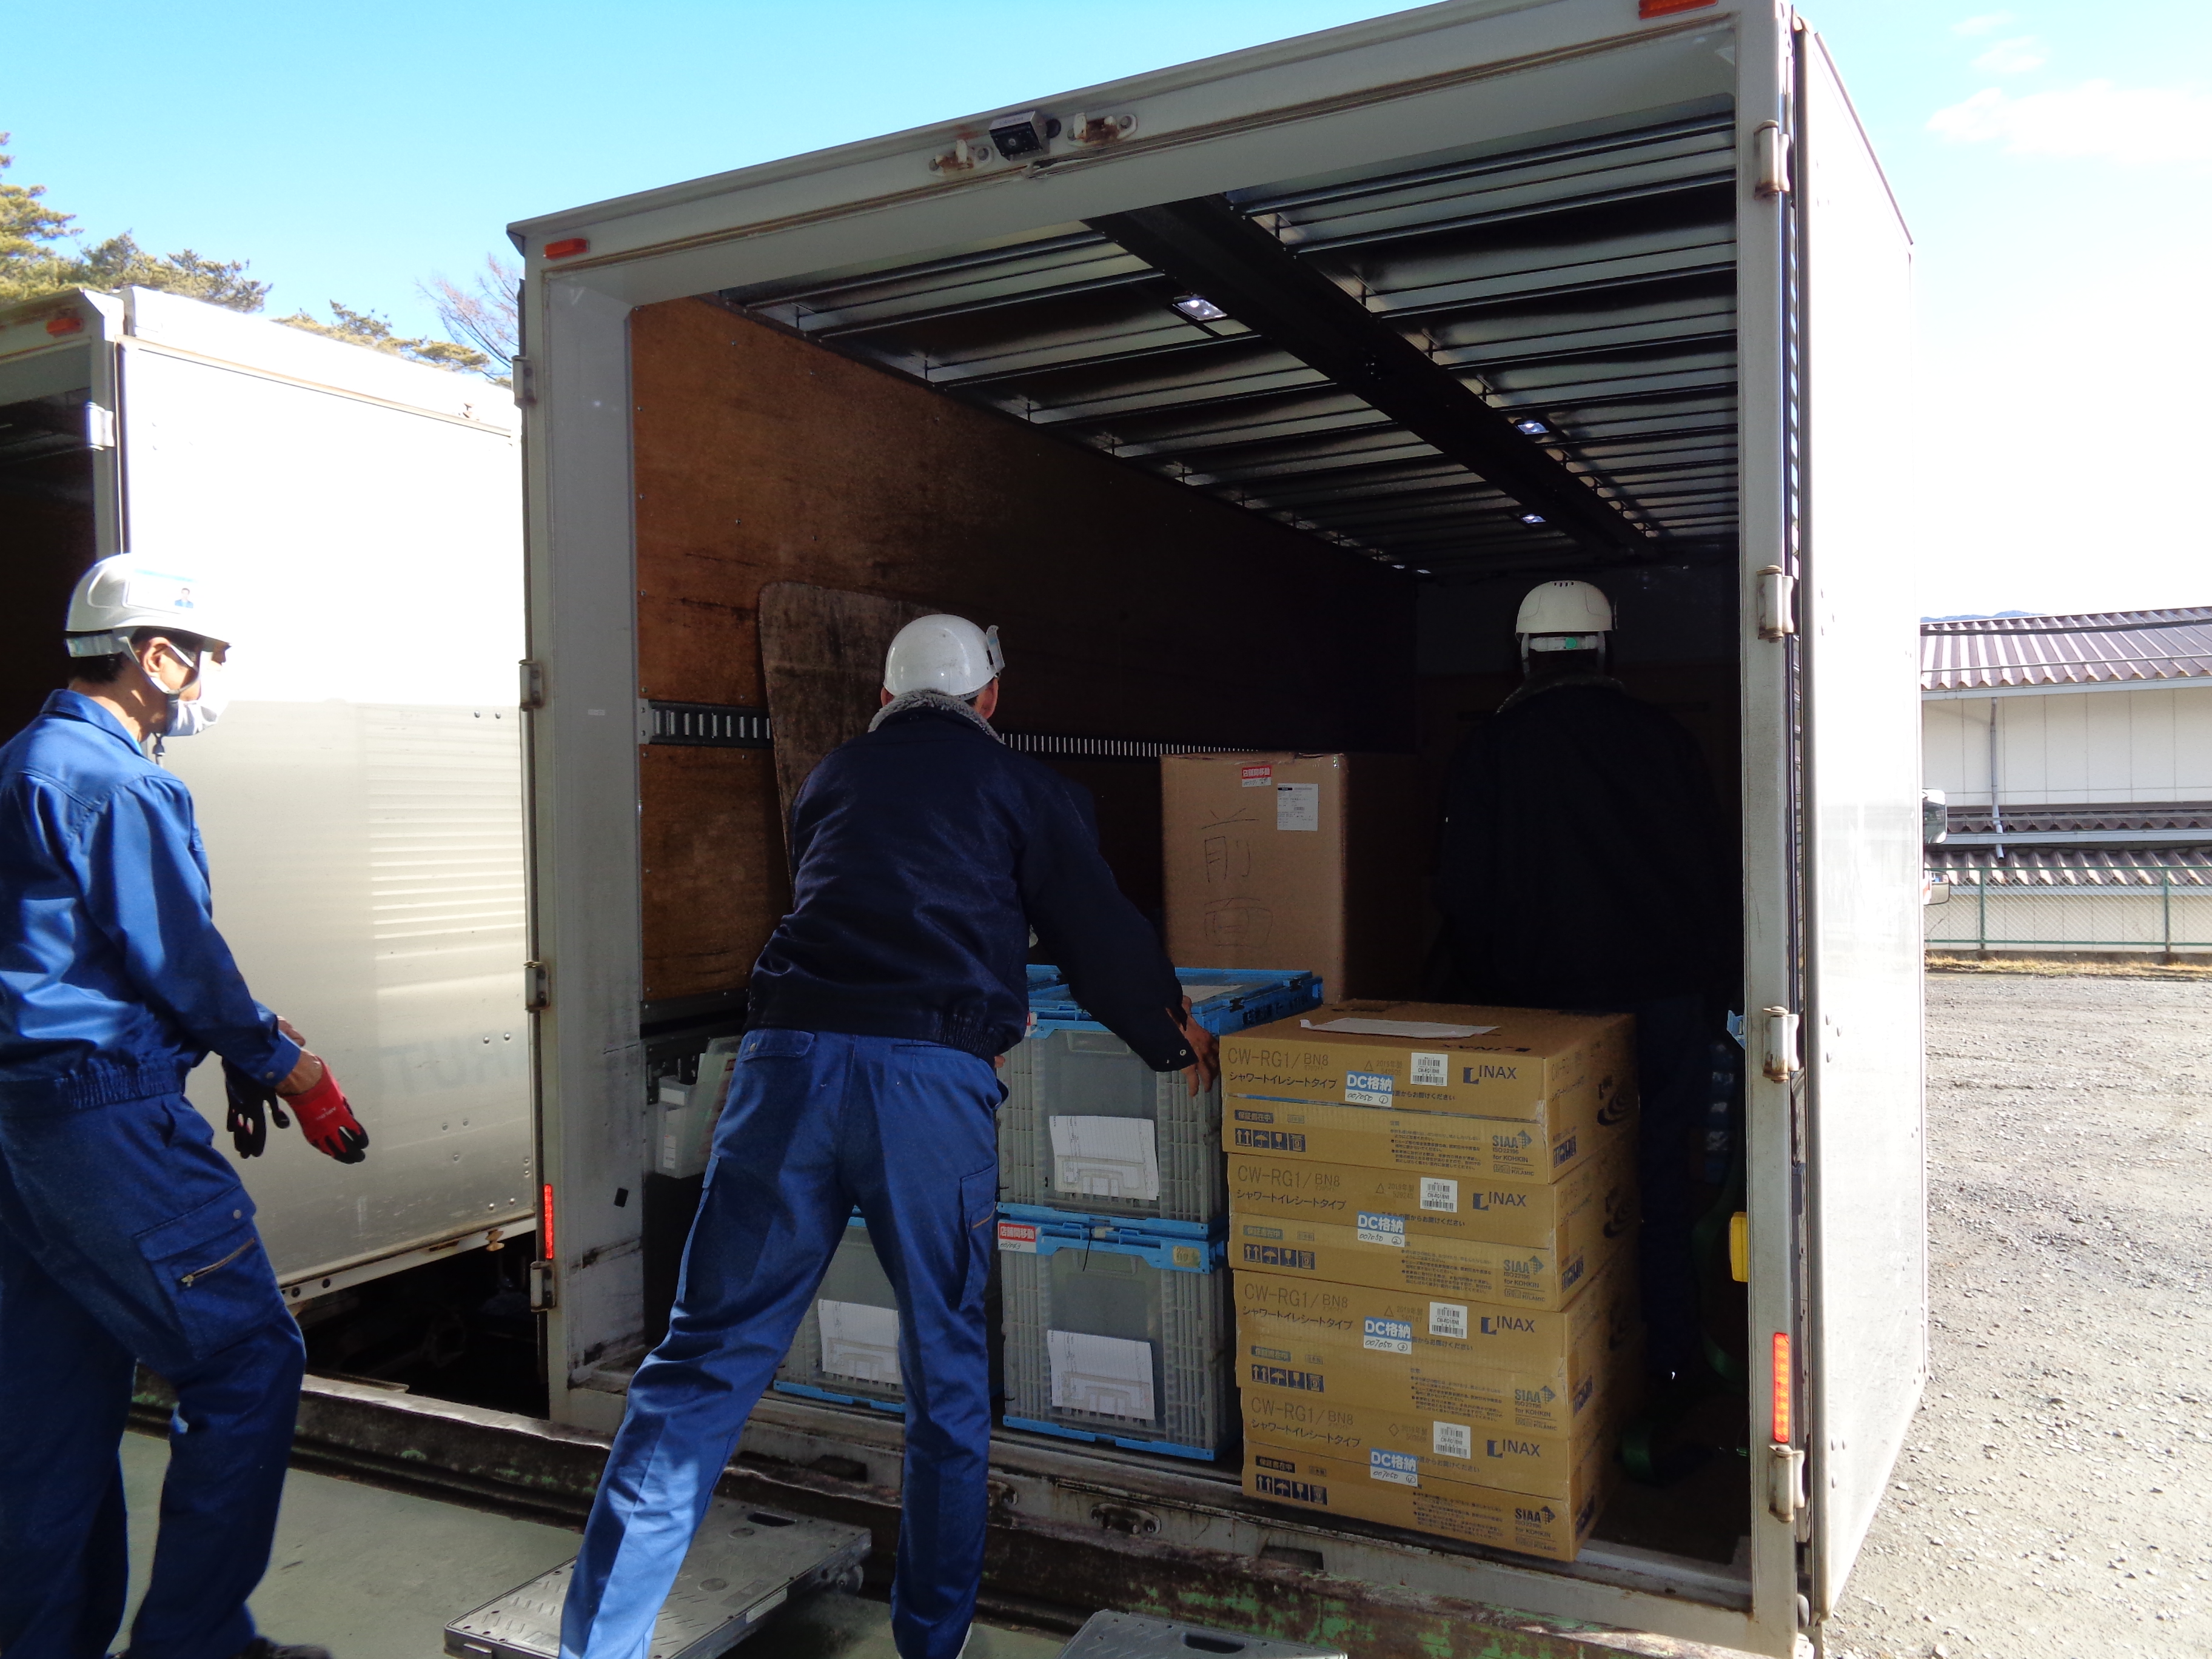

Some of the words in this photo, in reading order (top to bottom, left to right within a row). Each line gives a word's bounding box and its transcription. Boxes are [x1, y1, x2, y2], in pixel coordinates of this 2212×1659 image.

[1229, 1071, 1338, 1089] シャワートイレシートタイプ
[1479, 1065, 1517, 1079] INAX
[1347, 1074, 1393, 1092] DC格納
[1492, 1135, 1519, 1148] SIAA
[1237, 1189, 1347, 1210] シャワートイレシートタイプ
[1489, 1191, 1527, 1207] INAX
[1358, 1214, 1404, 1233] DC格納
[1000, 1225, 1034, 1241] 店舗間移動
[1504, 1259, 1530, 1274] SIAA
[1514, 1280, 1539, 1289] KOHKIN
[1243, 1306, 1353, 1330] シャワートイレシートタイプ
[1496, 1316, 1535, 1333] INAX
[1365, 1320, 1411, 1339] DC格納
[1515, 1389, 1541, 1403] SIAA
[1252, 1418, 1361, 1447] シャワートイレシートタイプ
[1503, 1439, 1541, 1457] INAX
[1371, 1452, 1416, 1472] DC格納
[1515, 1508, 1541, 1523] SIAA
